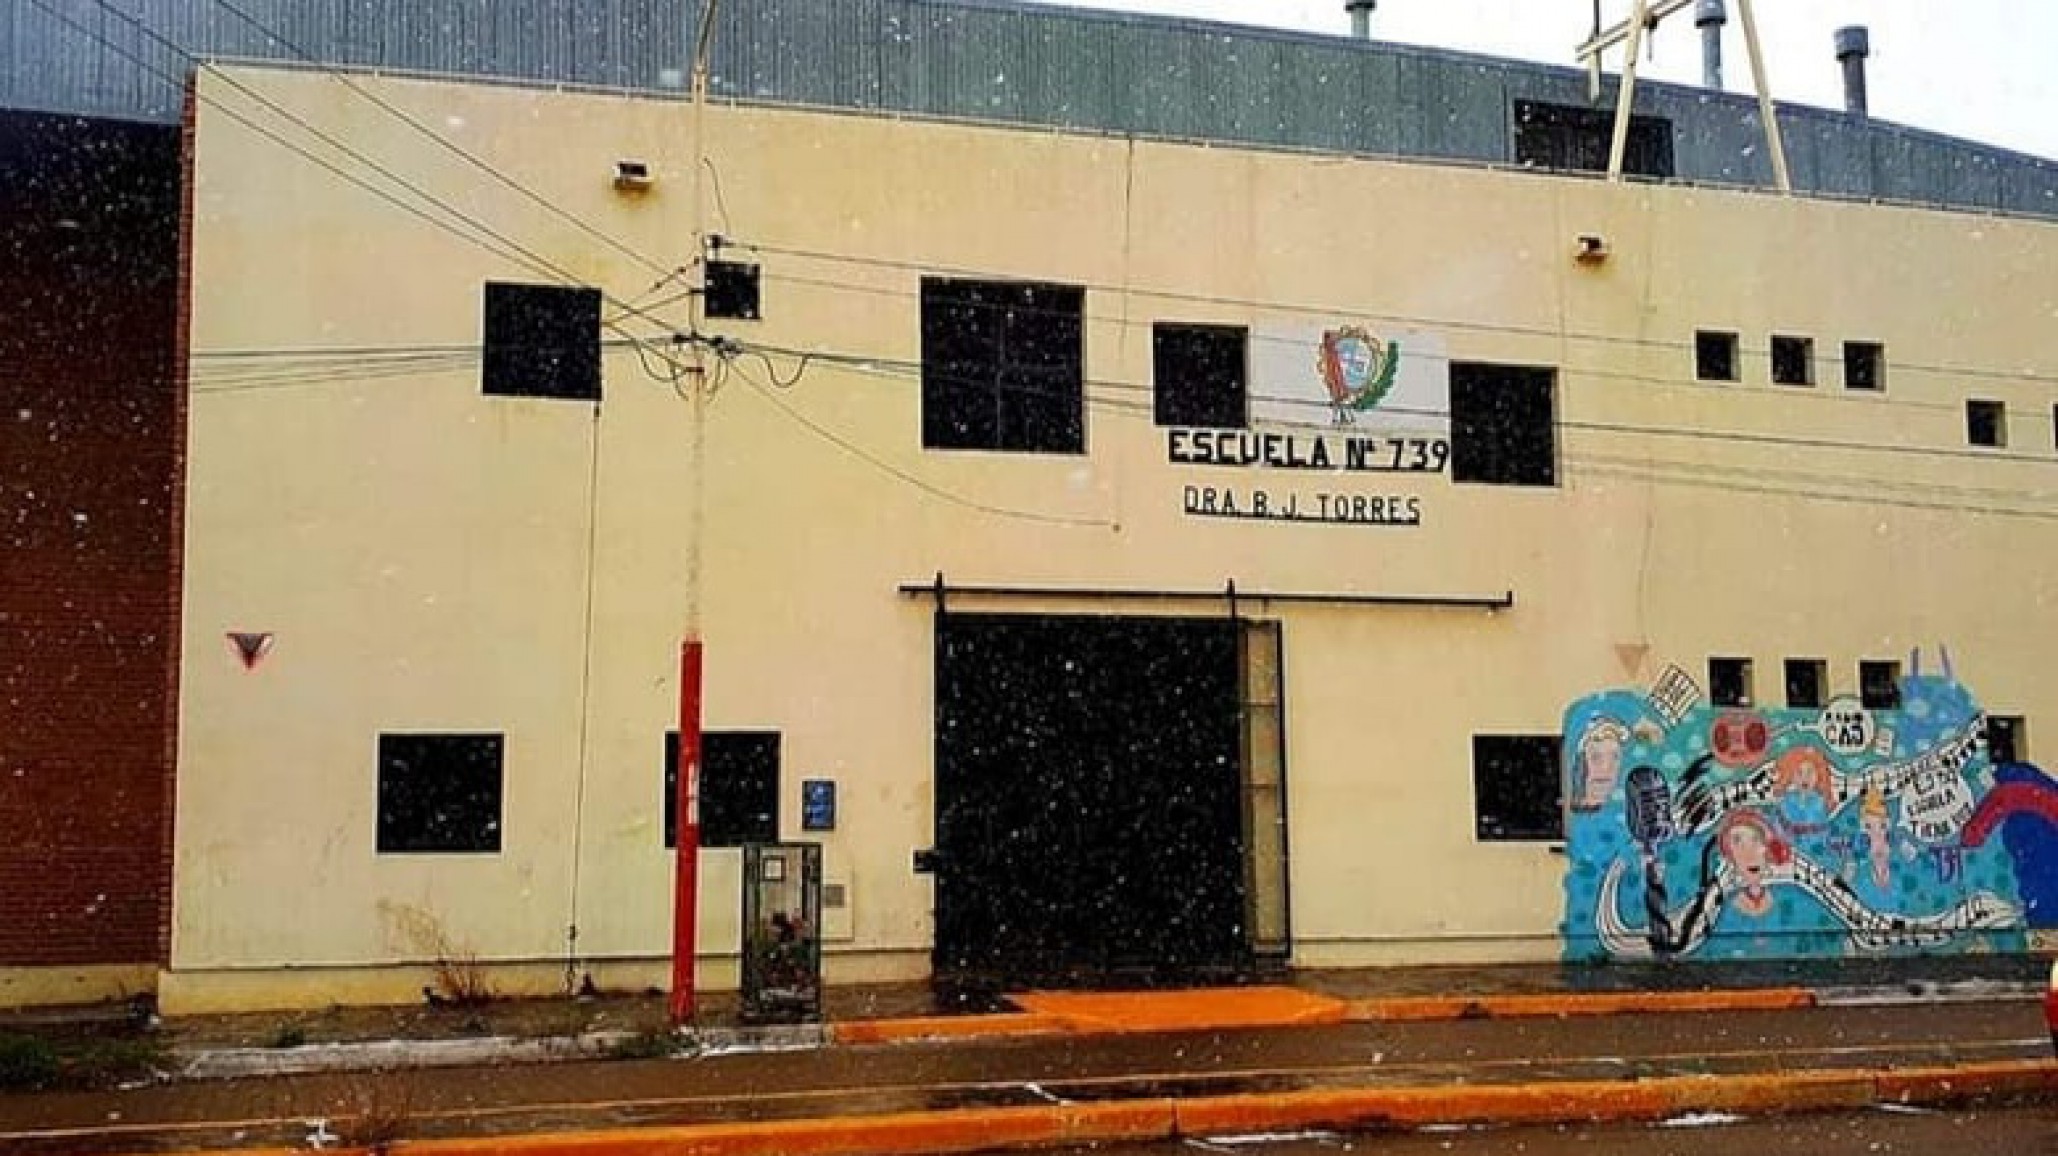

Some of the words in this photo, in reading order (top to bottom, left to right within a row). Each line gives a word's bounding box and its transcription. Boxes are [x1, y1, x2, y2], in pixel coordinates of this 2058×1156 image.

[1168, 429, 1331, 468] ESCUELA
[1387, 438, 1449, 472] 739
[1316, 493, 1420, 526] TORRES
